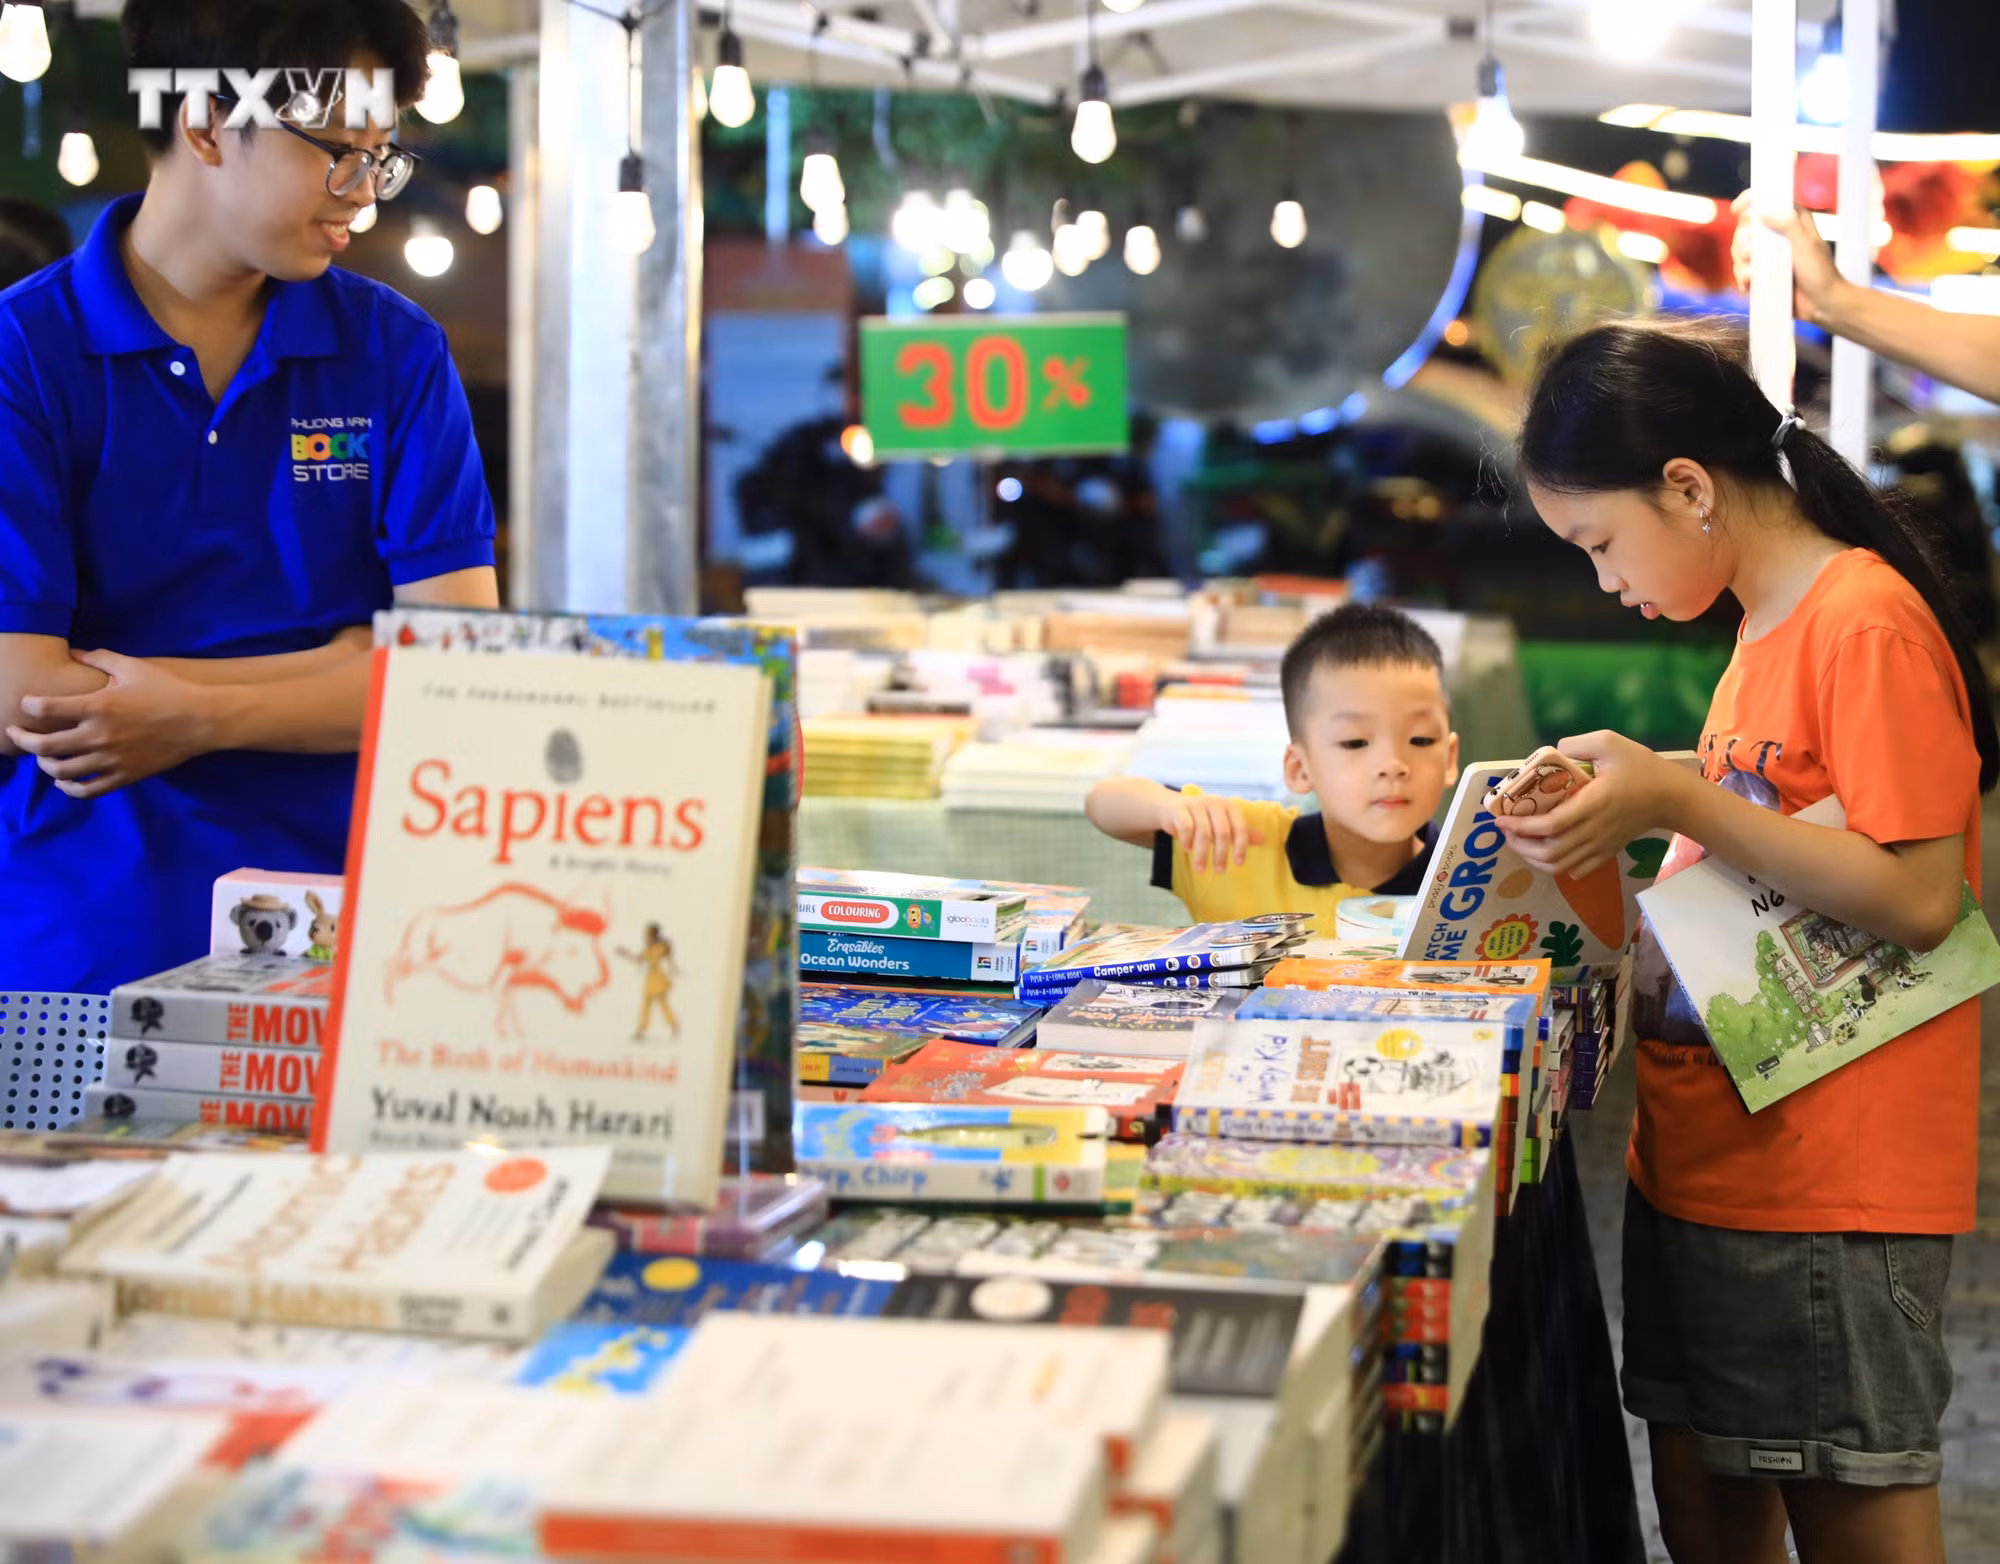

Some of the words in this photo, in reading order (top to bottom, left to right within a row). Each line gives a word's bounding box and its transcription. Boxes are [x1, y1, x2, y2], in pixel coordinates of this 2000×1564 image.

[291, 432, 370, 461] BOOK
[293, 463, 369, 482] STORE
[401, 758, 705, 866] Sapiens
[828, 904, 881, 919] COLOURING
[1424, 923, 1448, 961] ATCH
[1439, 929, 1468, 961] ME
[800, 952, 845, 967] Ocean
[847, 954, 910, 970] Wonders
[1093, 963, 1134, 977] Camper
[1137, 961, 1156, 973] van
[227, 1003, 249, 1041] THE
[219, 1051, 241, 1089] THE
[200, 1099, 220, 1125] HE
[371, 1086, 458, 1123] Yuval
[467, 1093, 555, 1130] Noah
[568, 1099, 675, 1139] Harari
[862, 1165, 928, 1196] Chirp
